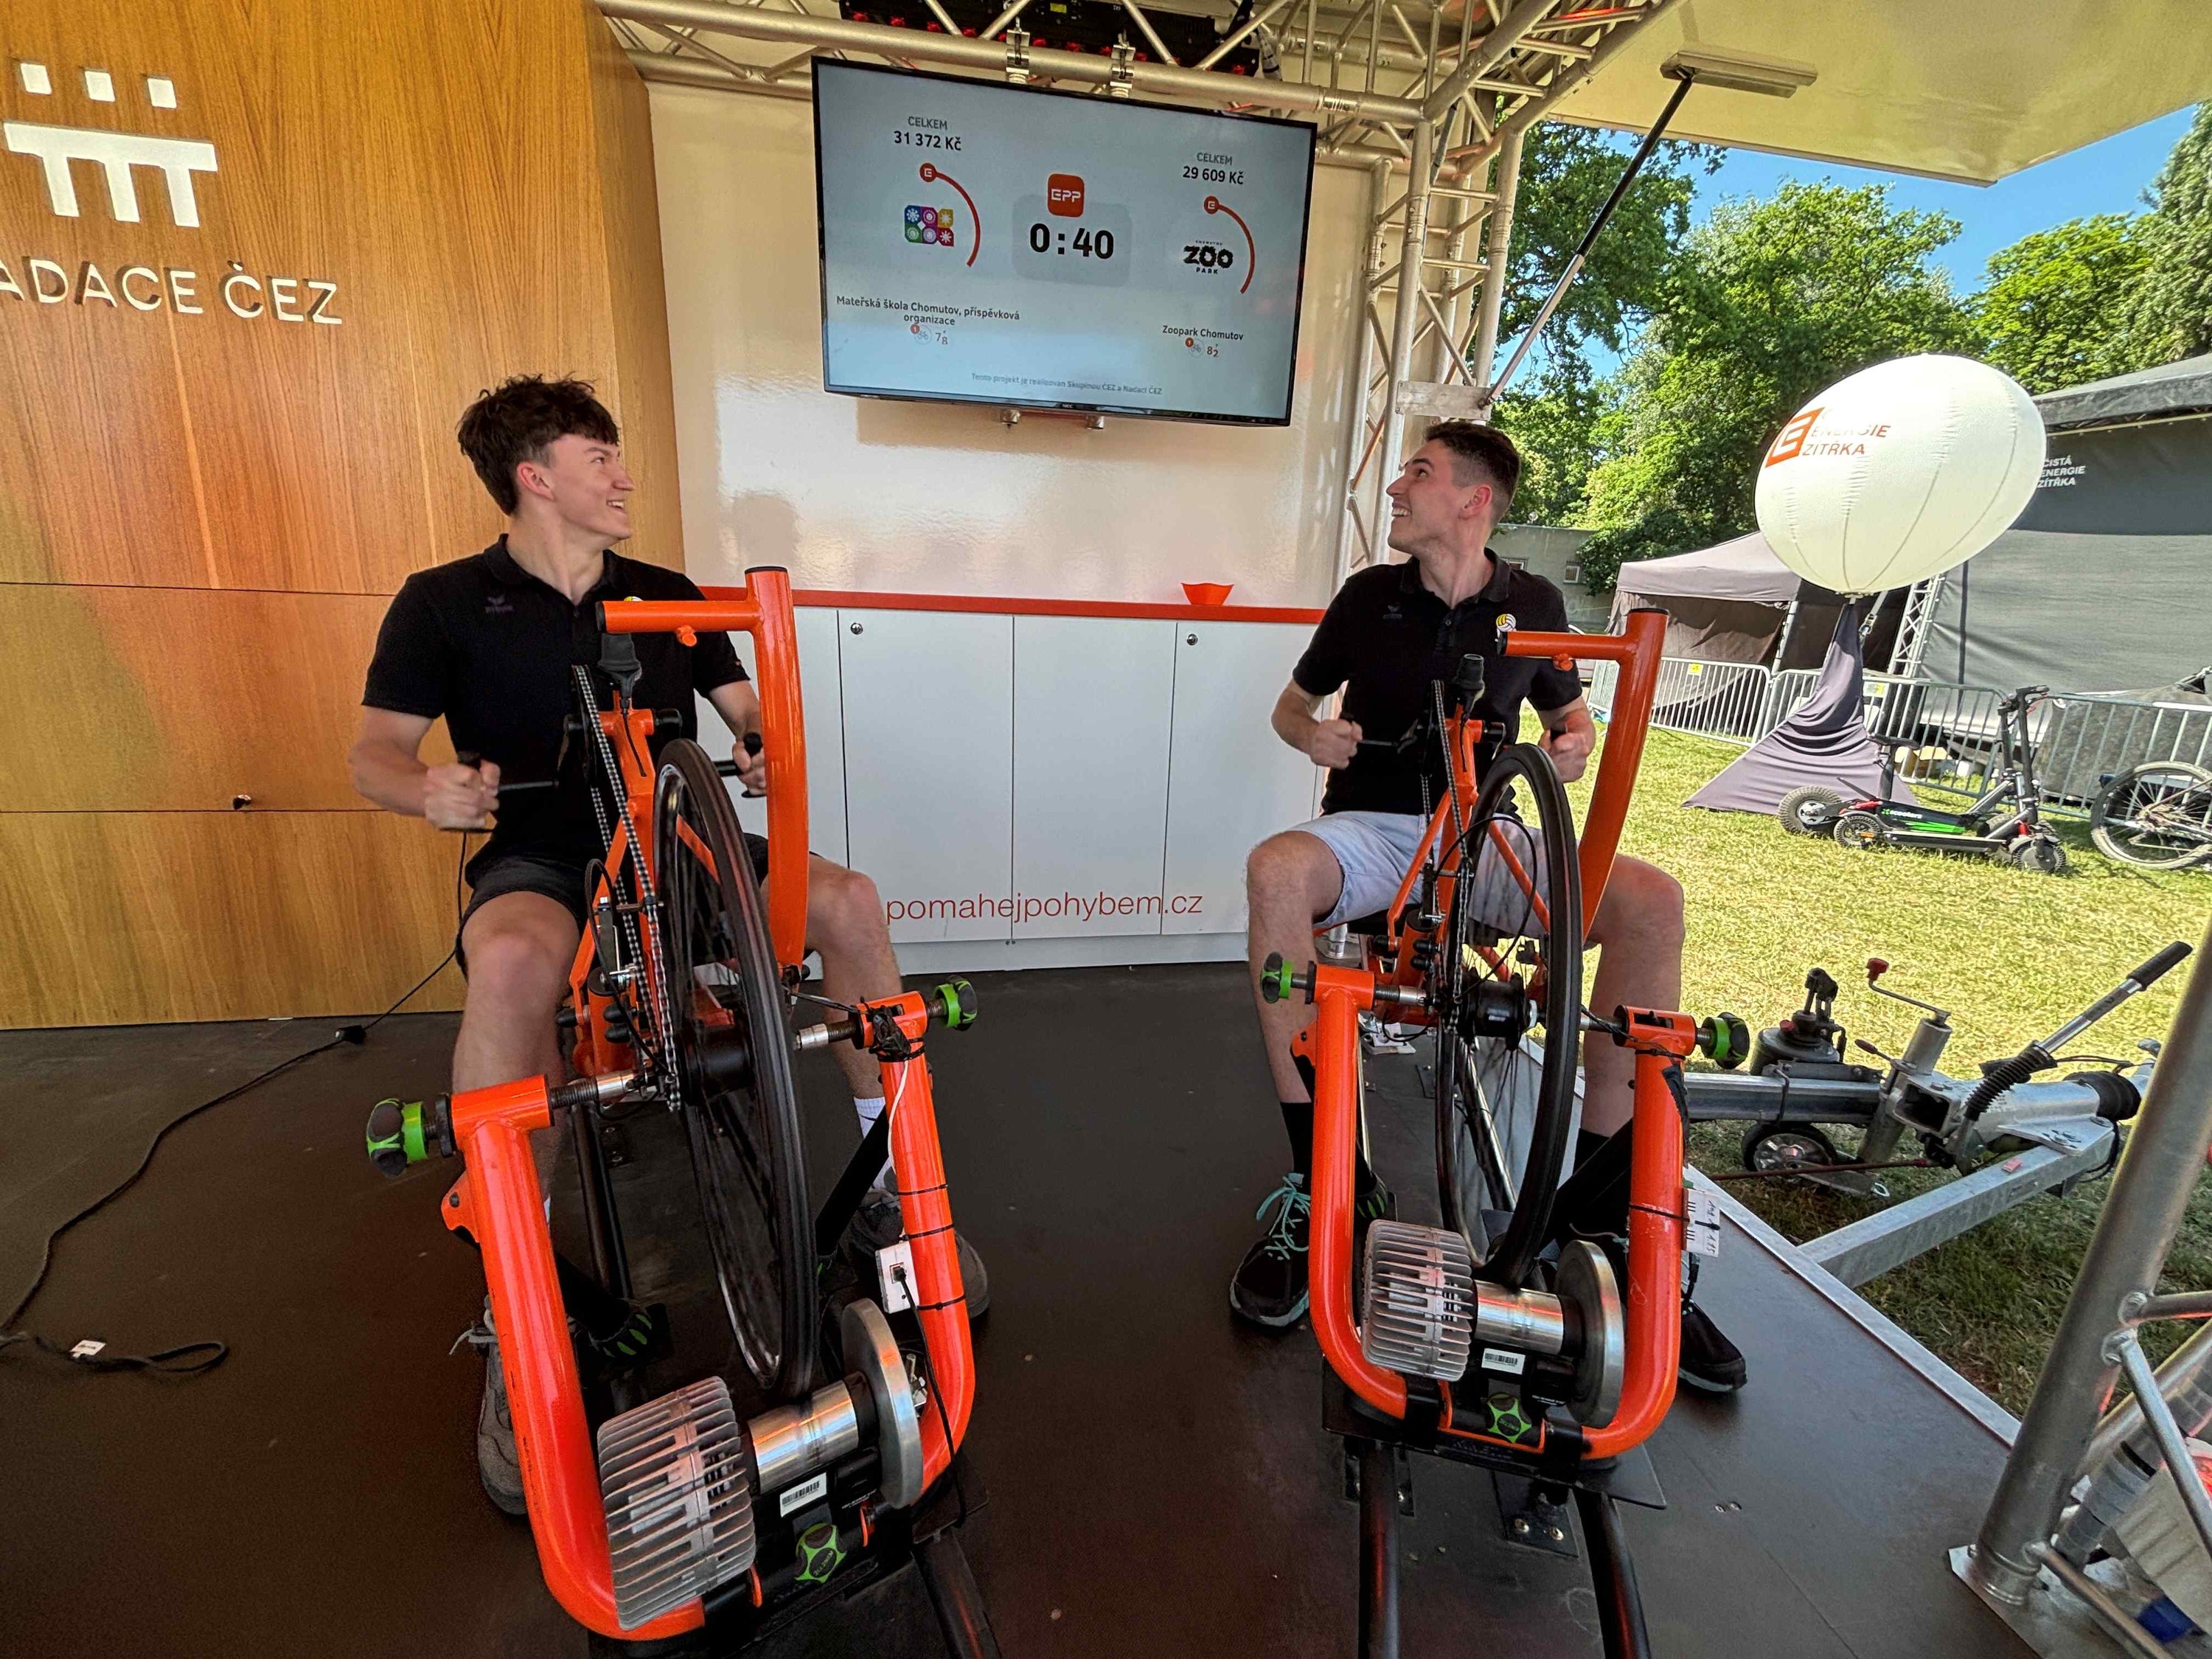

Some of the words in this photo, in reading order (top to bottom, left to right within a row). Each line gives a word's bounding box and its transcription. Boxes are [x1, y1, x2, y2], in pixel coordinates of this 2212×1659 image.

[908, 116, 947, 131] CELKEM
[893, 131, 910, 145] 31
[915, 133, 942, 148] 372
[945, 136, 962, 151] Kč
[1197, 152, 1233, 166] CELKEM
[1183, 166, 1199, 179] 29
[1202, 168, 1225, 183] 609
[1229, 171, 1245, 185] Kč
[1051, 188, 1081, 203] EPP
[1029, 223, 1114, 260] 0:40
[1196, 267, 1219, 275] PARK
[224, 262, 343, 325] ČEZ
[836, 296, 881, 308] Mateřská
[883, 299, 908, 310] škola
[911, 302, 961, 316] Chomutov,
[964, 307, 1020, 321] příspěvková
[903, 313, 956, 326] organizace
[1162, 325, 1198, 337] Zoopark
[1200, 328, 1244, 341] Chomutov
[971, 373, 992, 381] Tento
[993, 375, 1019, 384] projekt
[1020, 377, 1028, 386] je
[1102, 382, 1116, 392] ČEZ
[1149, 385, 1163, 395] ČEZ
[2040, 465, 2087, 478] ENERGIE
[2037, 477, 2076, 488] ZÍTŘKA
[886, 891, 1203, 925] pomahejpohybem.cz
